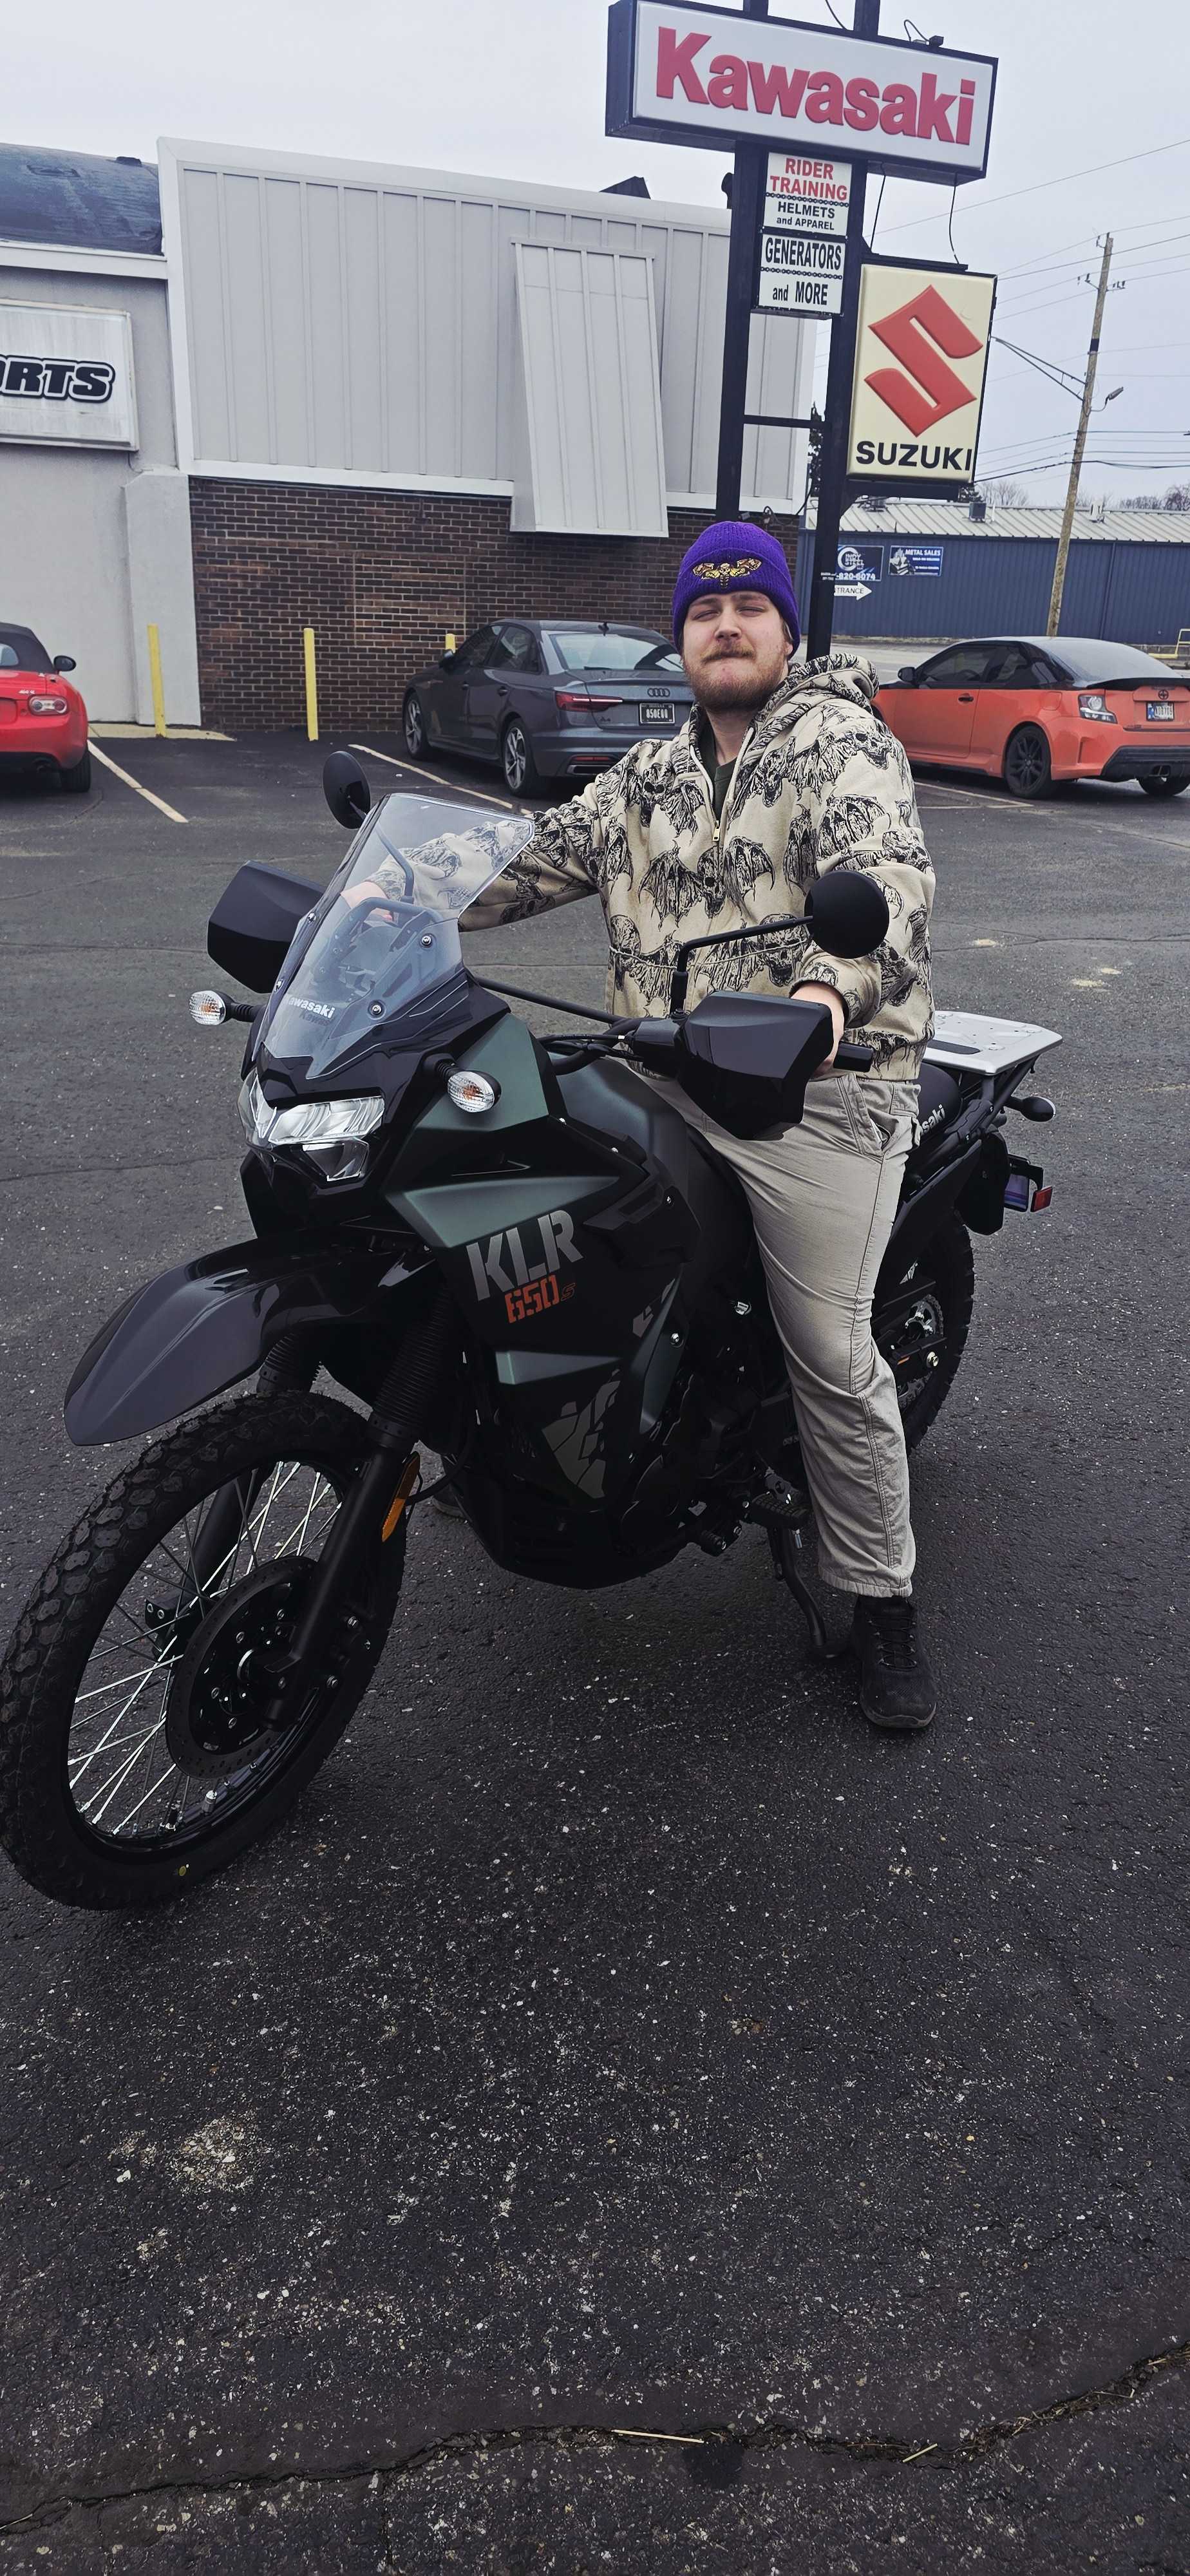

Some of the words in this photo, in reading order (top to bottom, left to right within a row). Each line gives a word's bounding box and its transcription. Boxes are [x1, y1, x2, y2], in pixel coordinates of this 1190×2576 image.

[656, 26, 976, 146] Kawasaki
[786, 158, 834, 180] RIDER
[770, 176, 847, 200] TRAINING
[778, 202, 835, 218] HELMETS
[795, 218, 835, 230] APPAREL
[766, 238, 842, 270] GENERATORS
[773, 285, 789, 301] and
[795, 281, 828, 305] MORE
[856, 441, 972, 471] SUZUKI
[288, 997, 335, 1018] awasaki
[921, 1104, 945, 1133] saki
[466, 1209, 583, 1302] KLR
[504, 1274, 560, 1323] 650
